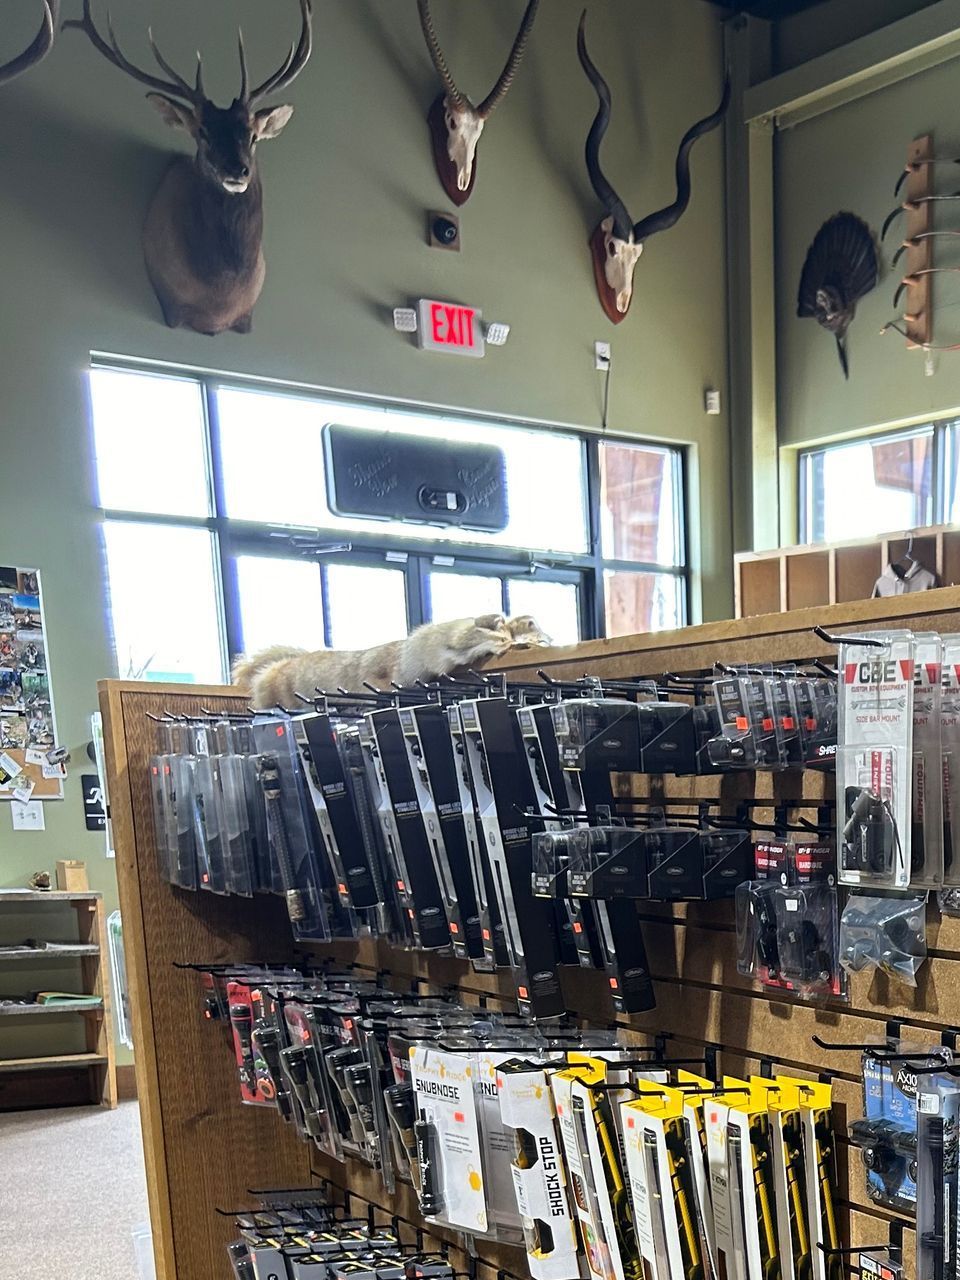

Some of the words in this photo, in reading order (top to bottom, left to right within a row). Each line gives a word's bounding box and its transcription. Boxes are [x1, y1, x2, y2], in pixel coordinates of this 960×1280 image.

[431, 304, 474, 347] EXIT
[859, 660, 897, 684] CBE
[851, 685, 868, 693] CUSTOM
[856, 715, 869, 723] SIDE
[882, 714, 901, 722] MOUNT
[416, 1079, 460, 1100] SNUBNOSE
[897, 1070, 918, 1087] AXIO
[539, 1136, 557, 1170] STOP
[546, 1170, 565, 1217] SHOCK
